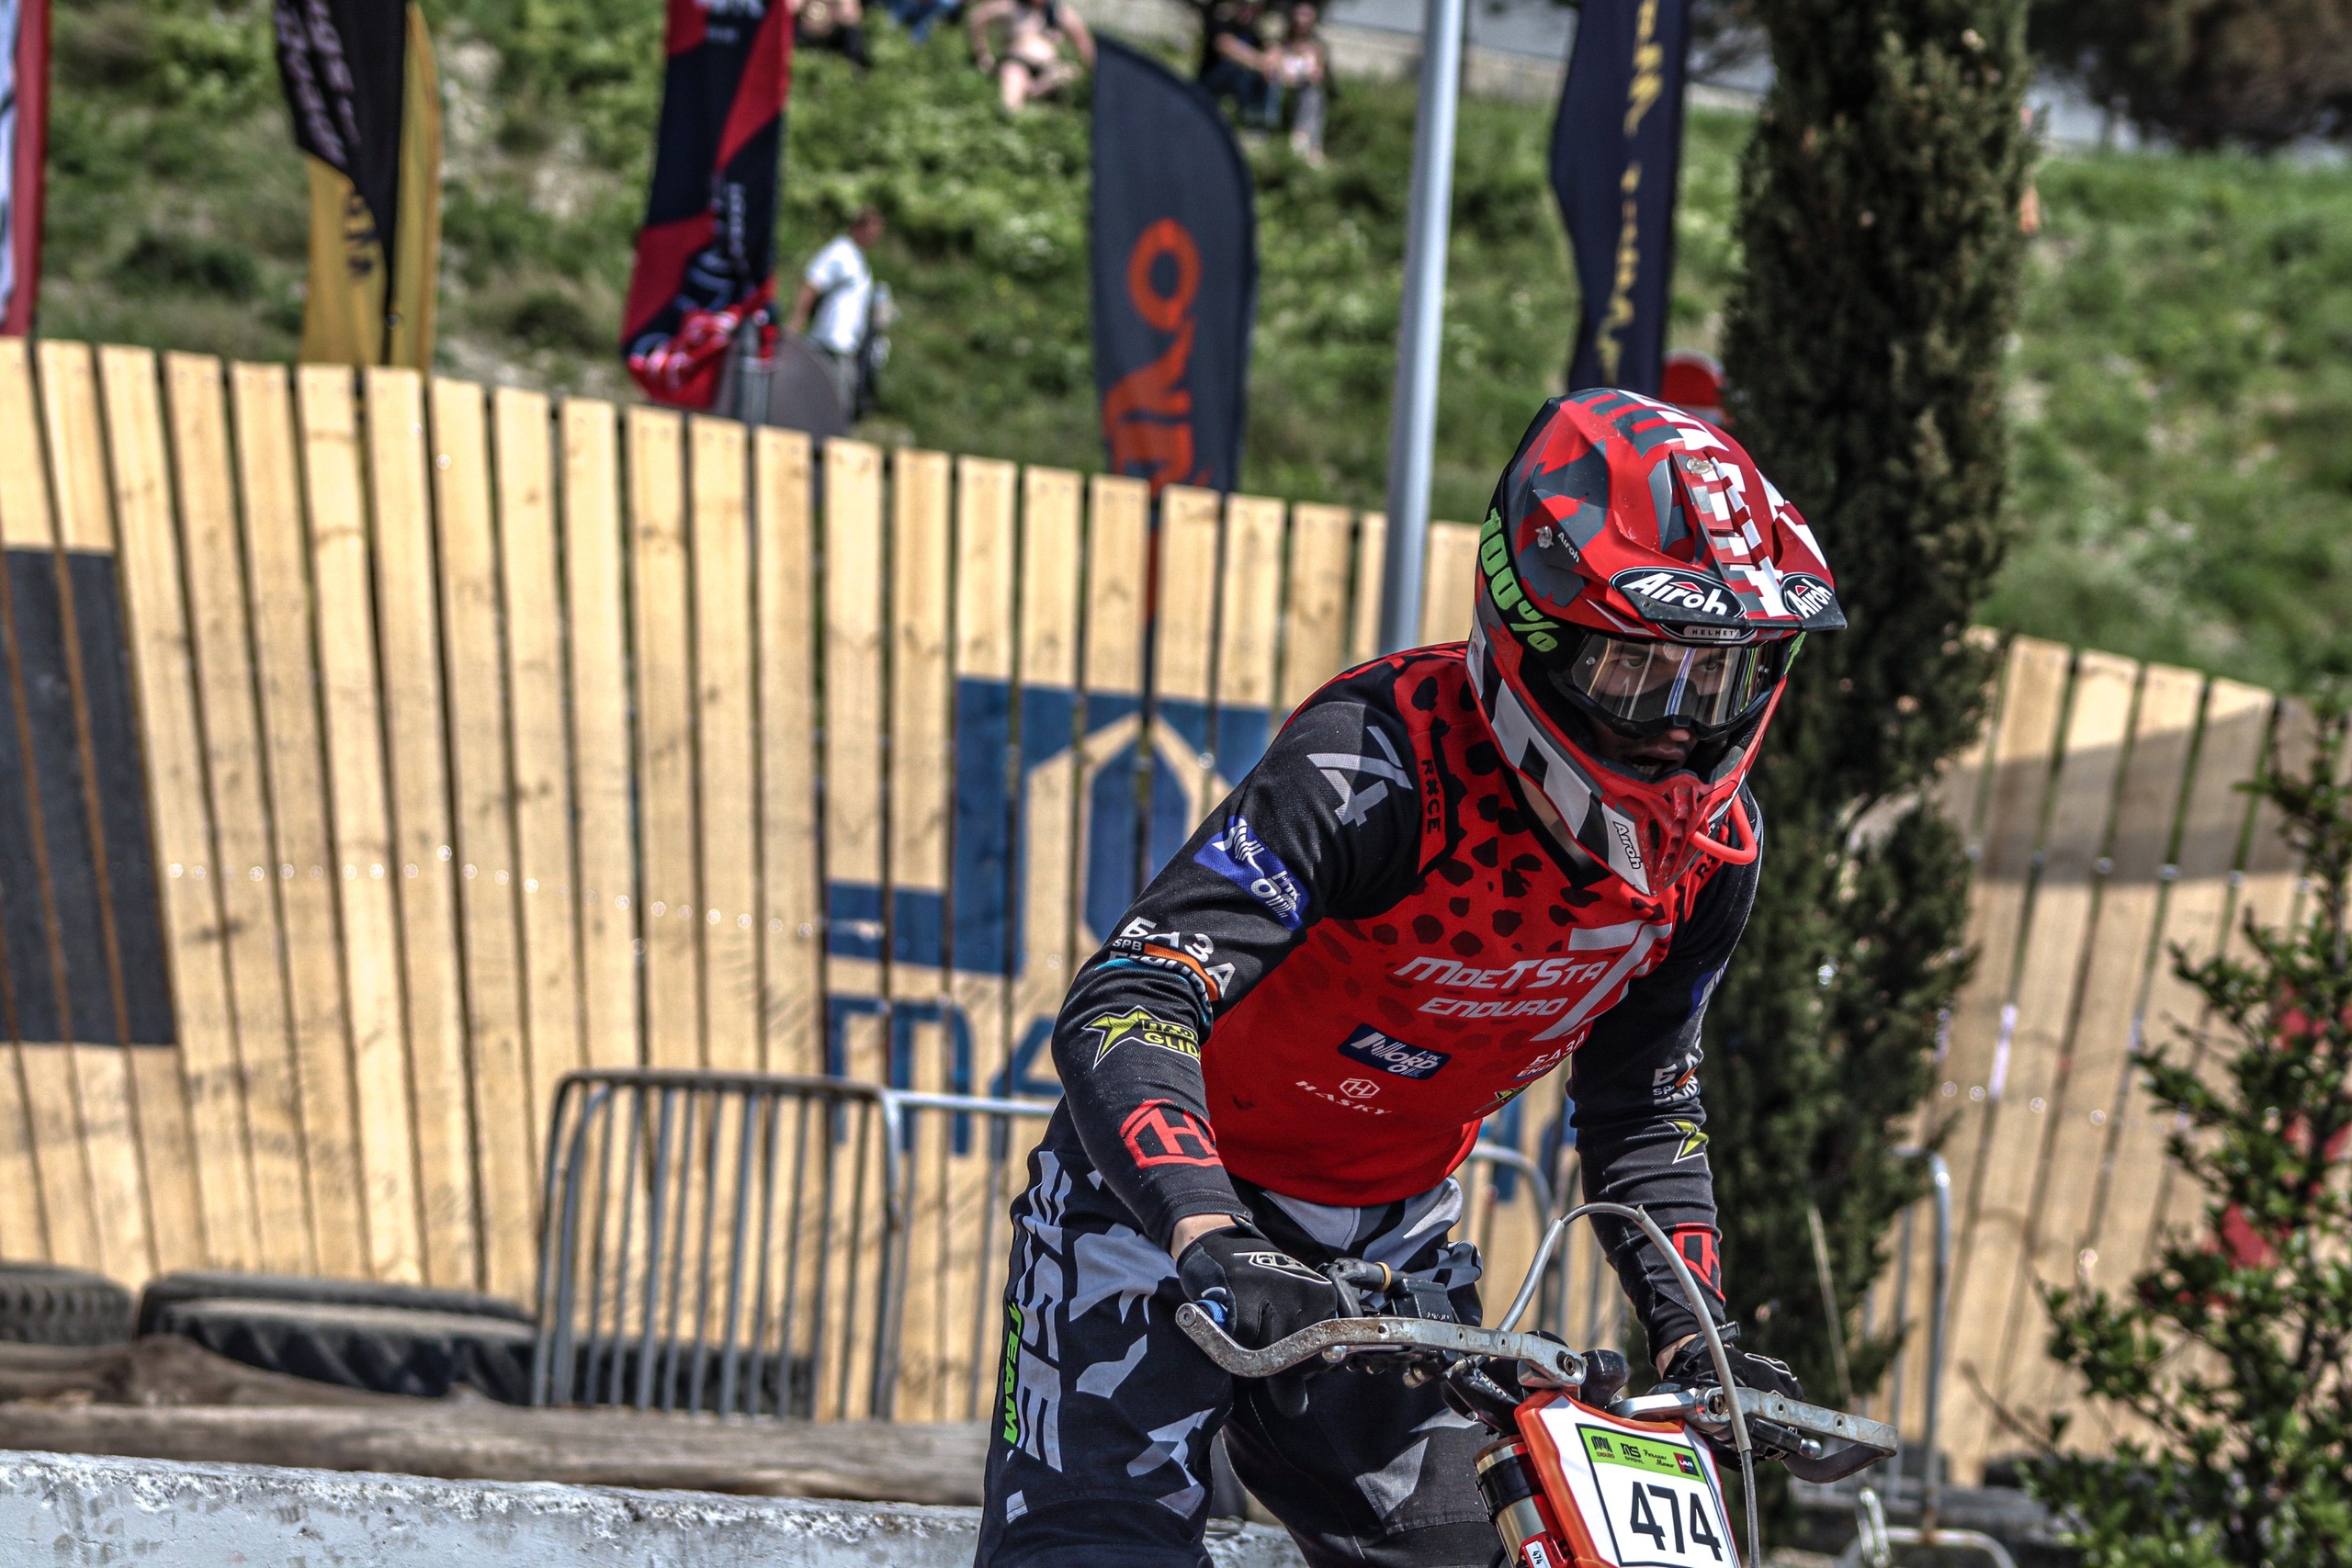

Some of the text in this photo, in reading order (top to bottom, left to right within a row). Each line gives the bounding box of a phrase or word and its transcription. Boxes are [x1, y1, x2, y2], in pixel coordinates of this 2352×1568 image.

[1556, 531, 1581, 563] Airoh
[1480, 507, 1560, 652] 100%
[1620, 571, 1728, 617] Airoh
[1786, 578, 1834, 619] Airoh
[1612, 820, 1643, 870] Airoh
[1112, 938, 1143, 952] SPB
[1417, 997, 1569, 1019] ENDURO
[1144, 1032, 1202, 1060] GLID
[1350, 1032, 1439, 1069] NORD
[1003, 1302, 1023, 1445] TEAM
[1630, 1481, 1724, 1562] 474
[1532, 1550, 1544, 1565] 474
